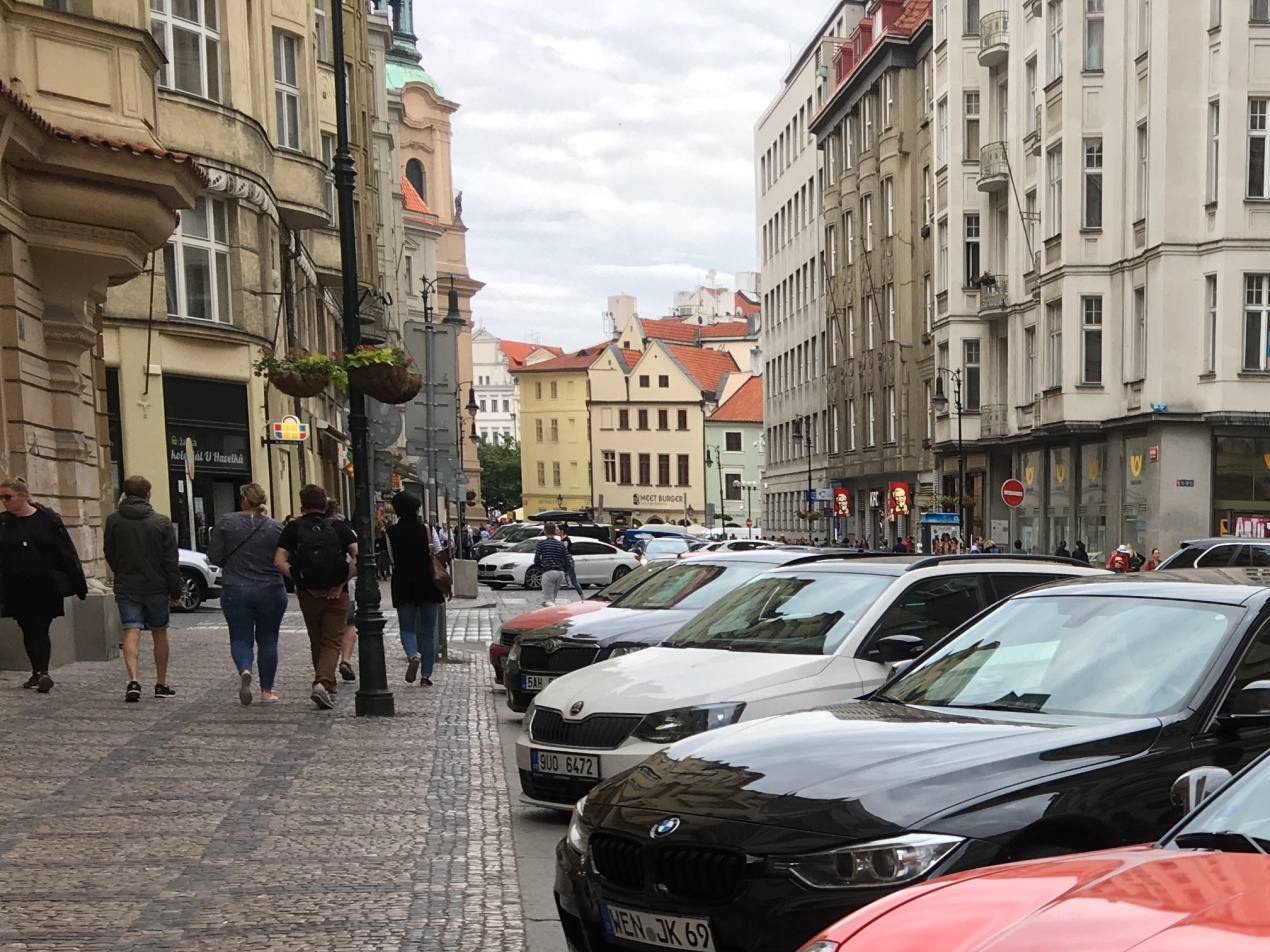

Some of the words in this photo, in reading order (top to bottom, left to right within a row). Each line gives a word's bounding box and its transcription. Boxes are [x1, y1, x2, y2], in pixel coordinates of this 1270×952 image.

[640, 494, 657, 502] MEET
[658, 495, 683, 503] BURGER
[869, 490, 879, 507] KFC
[527, 676, 543, 689] 5AH
[566, 756, 593, 776] 6472
[655, 918, 683, 946] JK
[685, 921, 710, 949] 69
